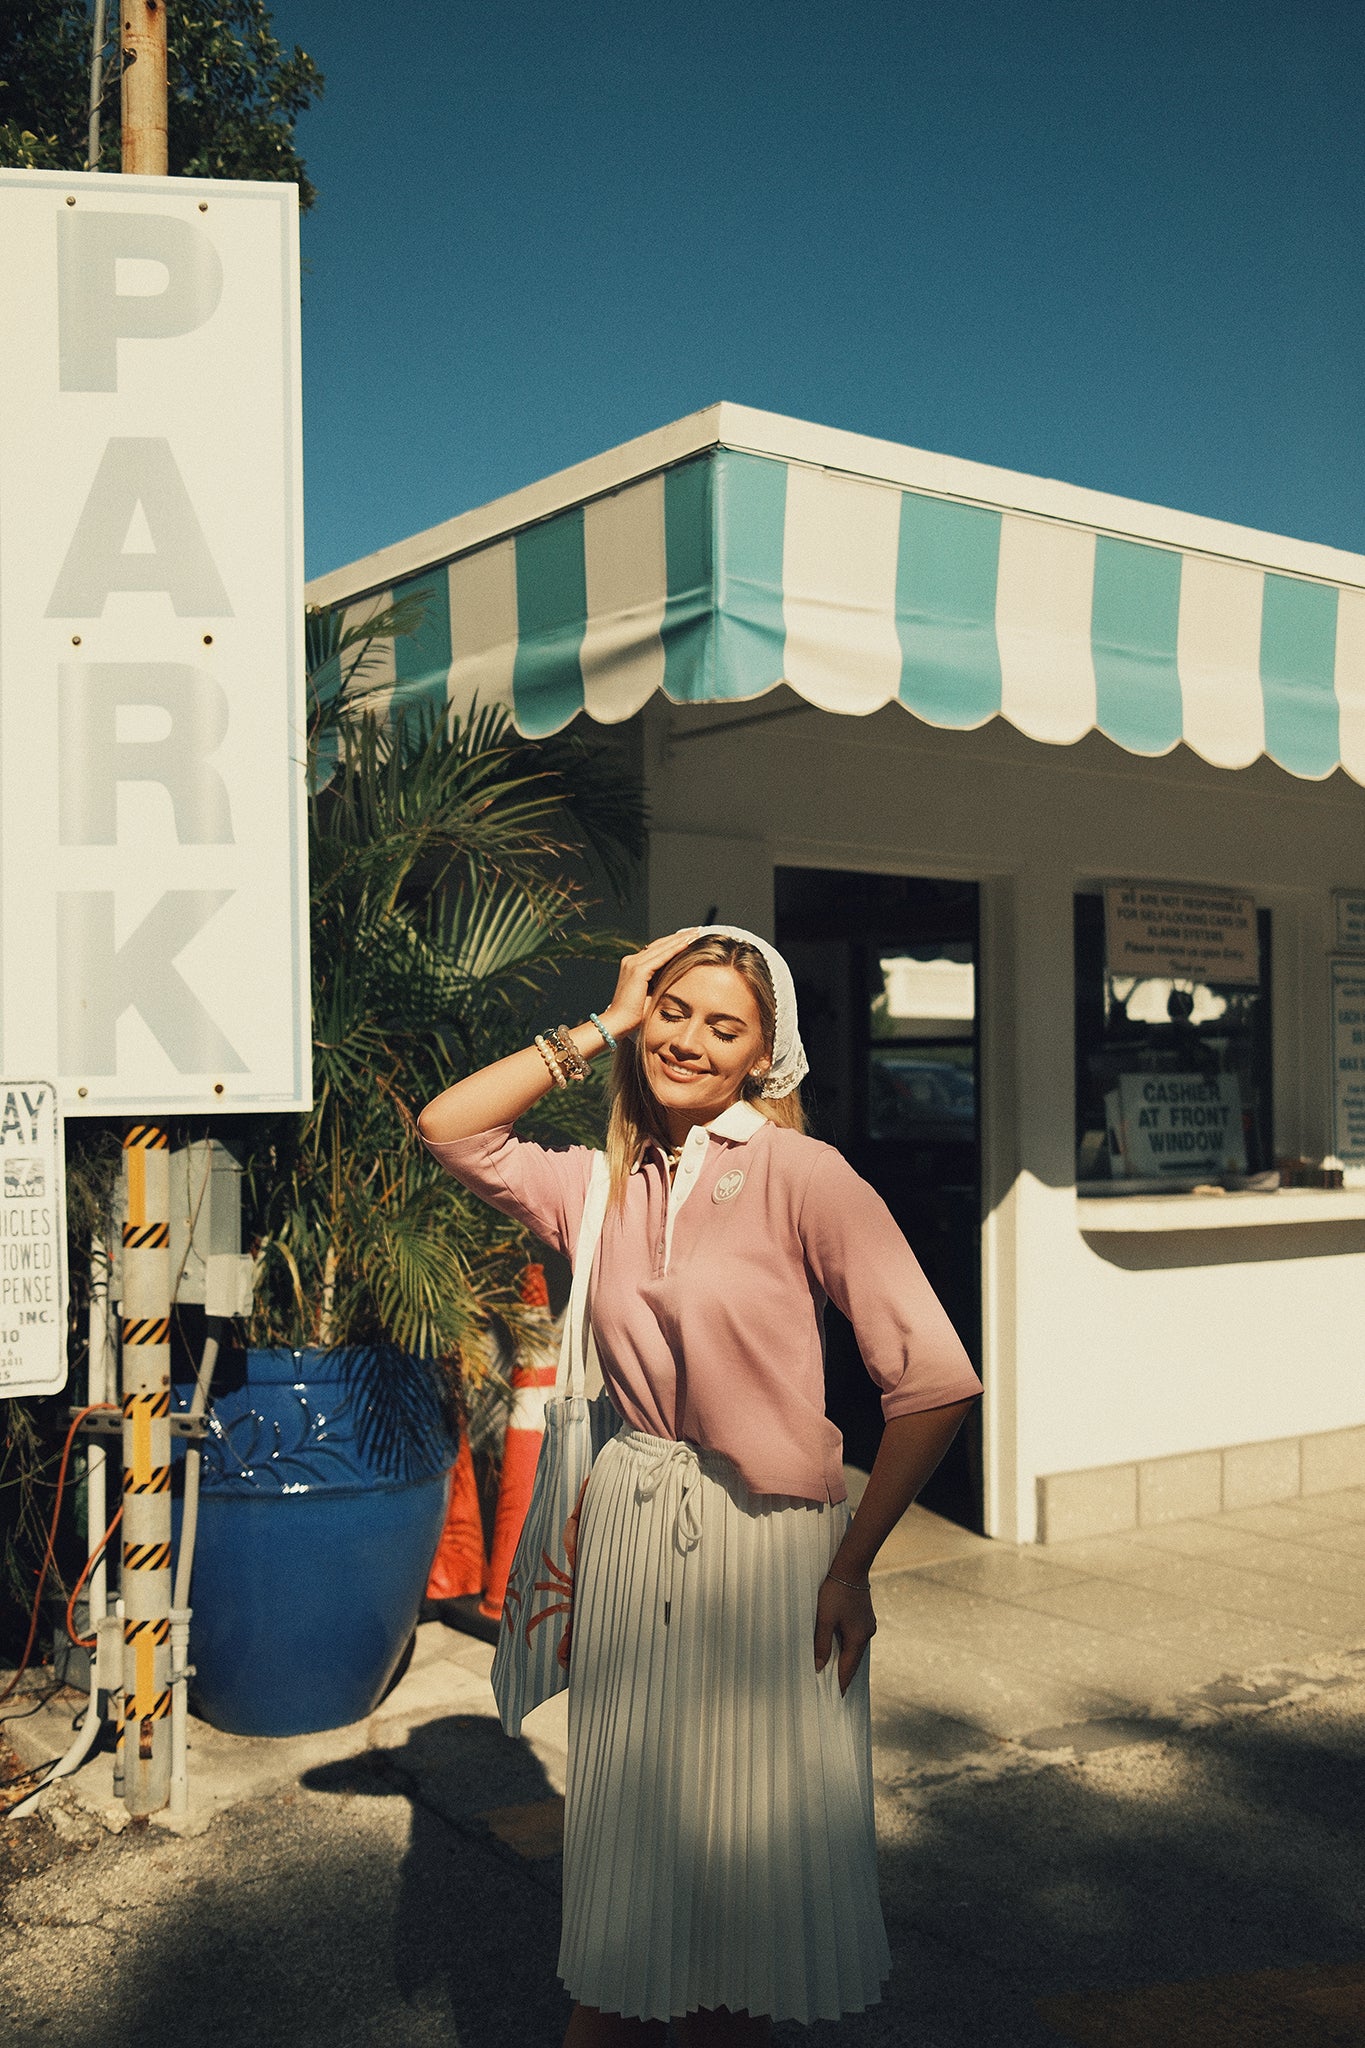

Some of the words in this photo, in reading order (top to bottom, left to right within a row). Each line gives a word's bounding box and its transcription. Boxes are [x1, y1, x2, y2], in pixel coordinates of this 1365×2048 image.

[43, 209, 251, 1077] PARK
[1142, 1081, 1221, 1103] CASHIER
[1138, 1106, 1159, 1128] AT
[1169, 1105, 1230, 1127] FRONT
[1147, 1130, 1224, 1152] WINDOW
[0, 1208, 51, 1237] ICLES
[1, 1242, 52, 1271] TOWED
[19, 1310, 55, 1326] INC.
